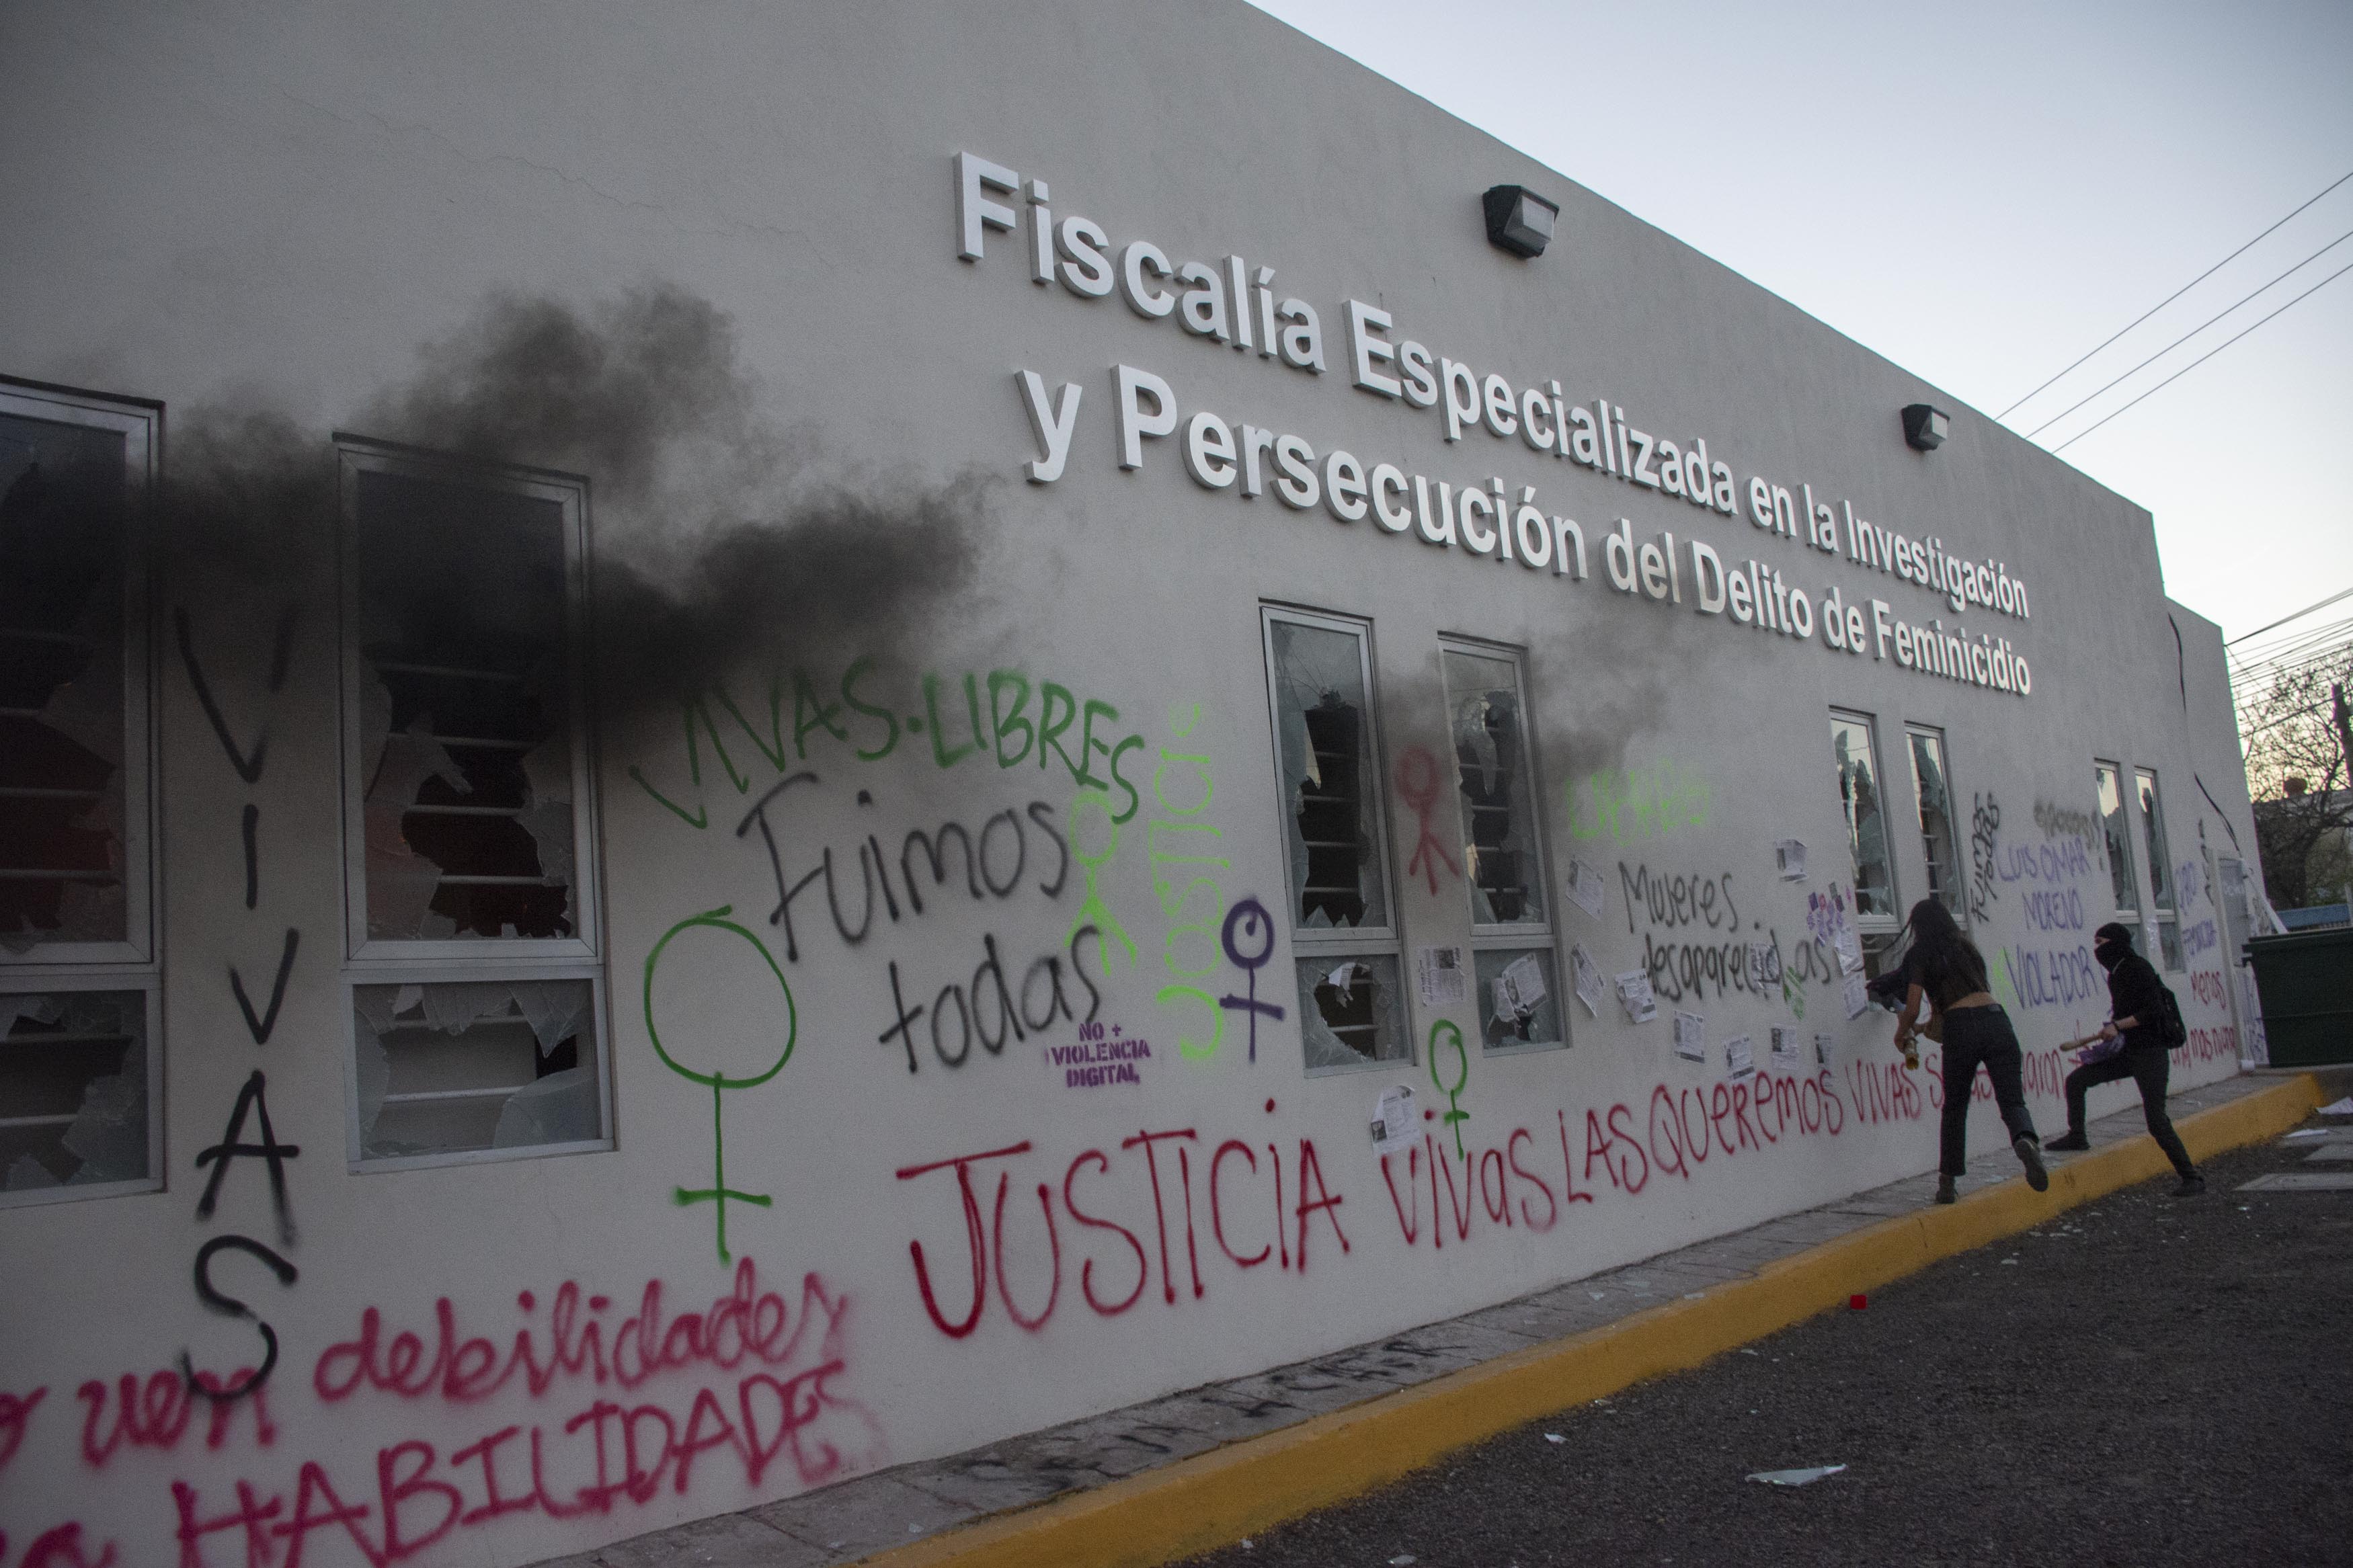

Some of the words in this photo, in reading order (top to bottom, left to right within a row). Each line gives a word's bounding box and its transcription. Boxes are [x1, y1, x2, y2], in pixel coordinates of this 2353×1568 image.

[953, 151, 1326, 374] Fiscalía
[1343, 299, 1739, 516] Especializada
[1748, 476, 1797, 538] en
[1799, 483, 1839, 554] la
[1839, 499, 2030, 619] Investigación
[1014, 370, 1083, 485] y
[1110, 364, 1589, 581] Persecución
[1600, 518, 1681, 604] del
[1686, 539, 1813, 640] Delito
[1819, 586, 1866, 655] de
[1866, 598, 2032, 697] Feminicidio
[2021, 886, 2084, 932] MORENO
[173, 604, 300, 1401] VIVAS
[879, 925, 1101, 1073] todas
[2003, 944, 2099, 1010] VIOLADOR
[1050, 1039, 1152, 1066] VIOLENCIA
[1078, 1021, 1105, 1042] NO
[1066, 1063, 1141, 1088] DIGITAL
[1558, 1102, 1649, 1203] LAS
